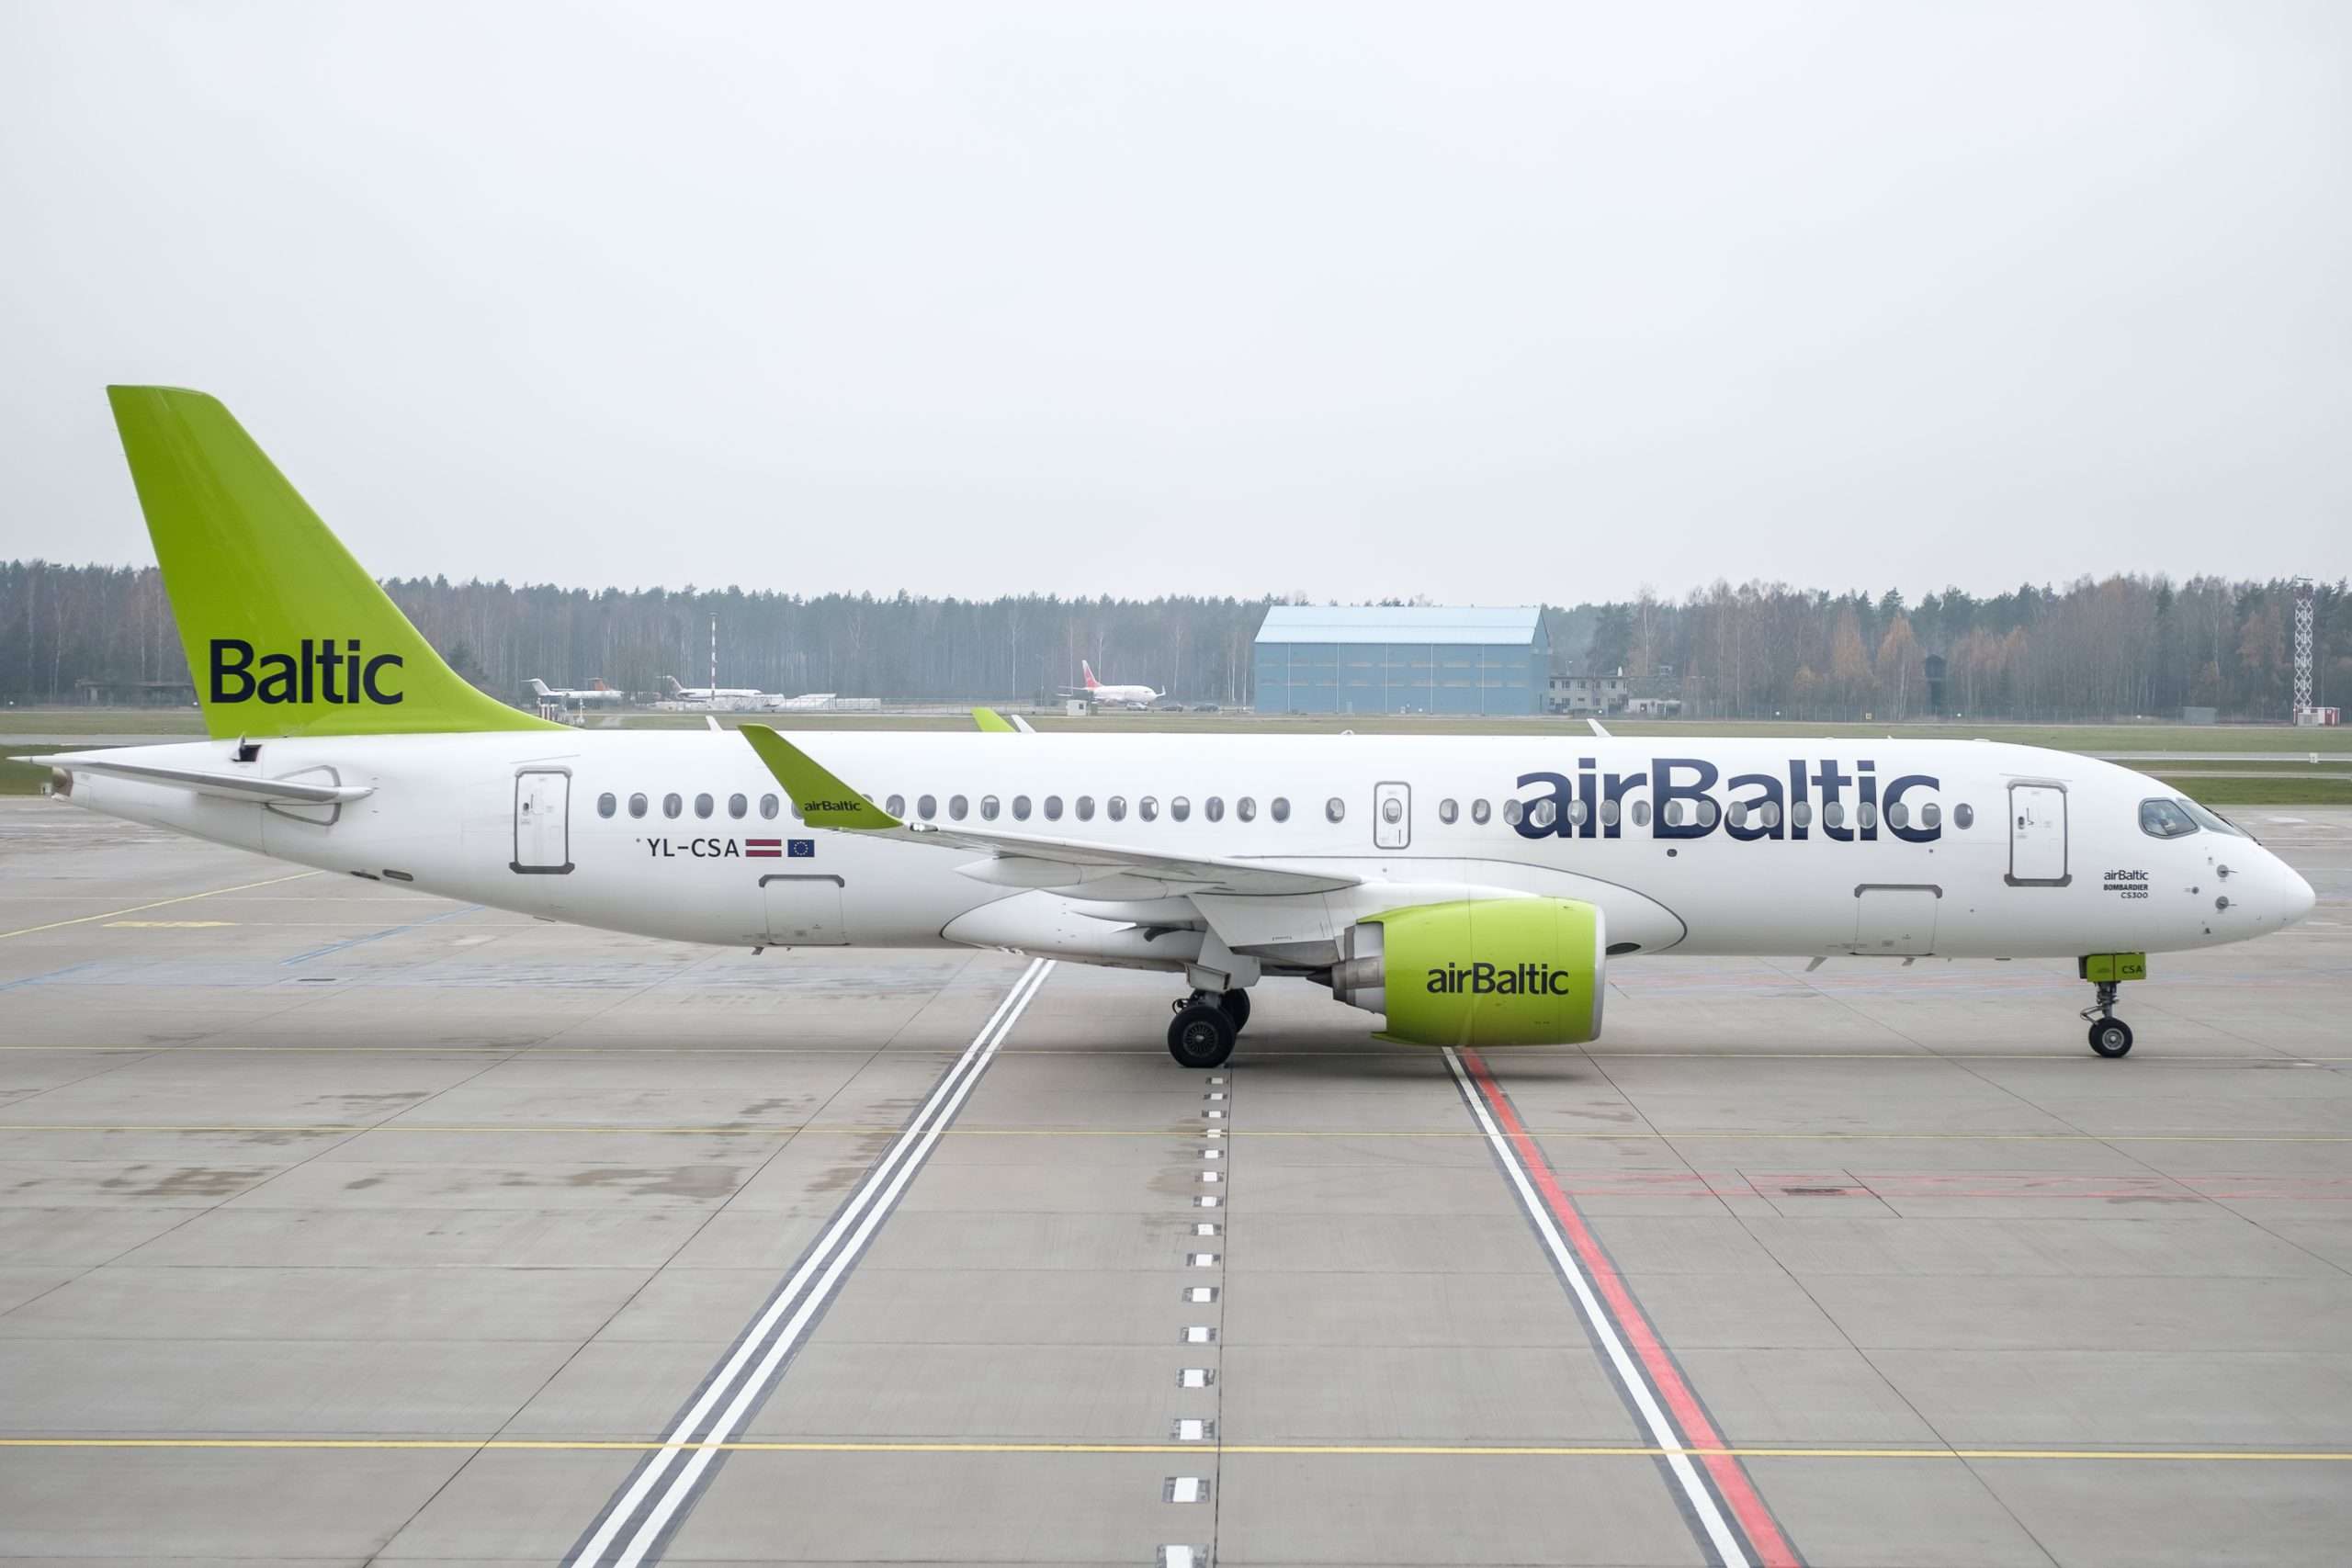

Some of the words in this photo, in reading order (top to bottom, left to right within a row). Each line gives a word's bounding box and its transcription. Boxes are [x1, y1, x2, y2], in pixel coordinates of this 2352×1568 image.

[210, 639, 403, 704] Baltic
[804, 800, 862, 812] airBaltic
[1512, 758, 1941, 842] airBaltic
[647, 838, 740, 858] YL-CSA
[2103, 869, 2149, 881] airBaltic
[1427, 962, 1569, 995] airBaltic
[2121, 964, 2143, 975] CSA
